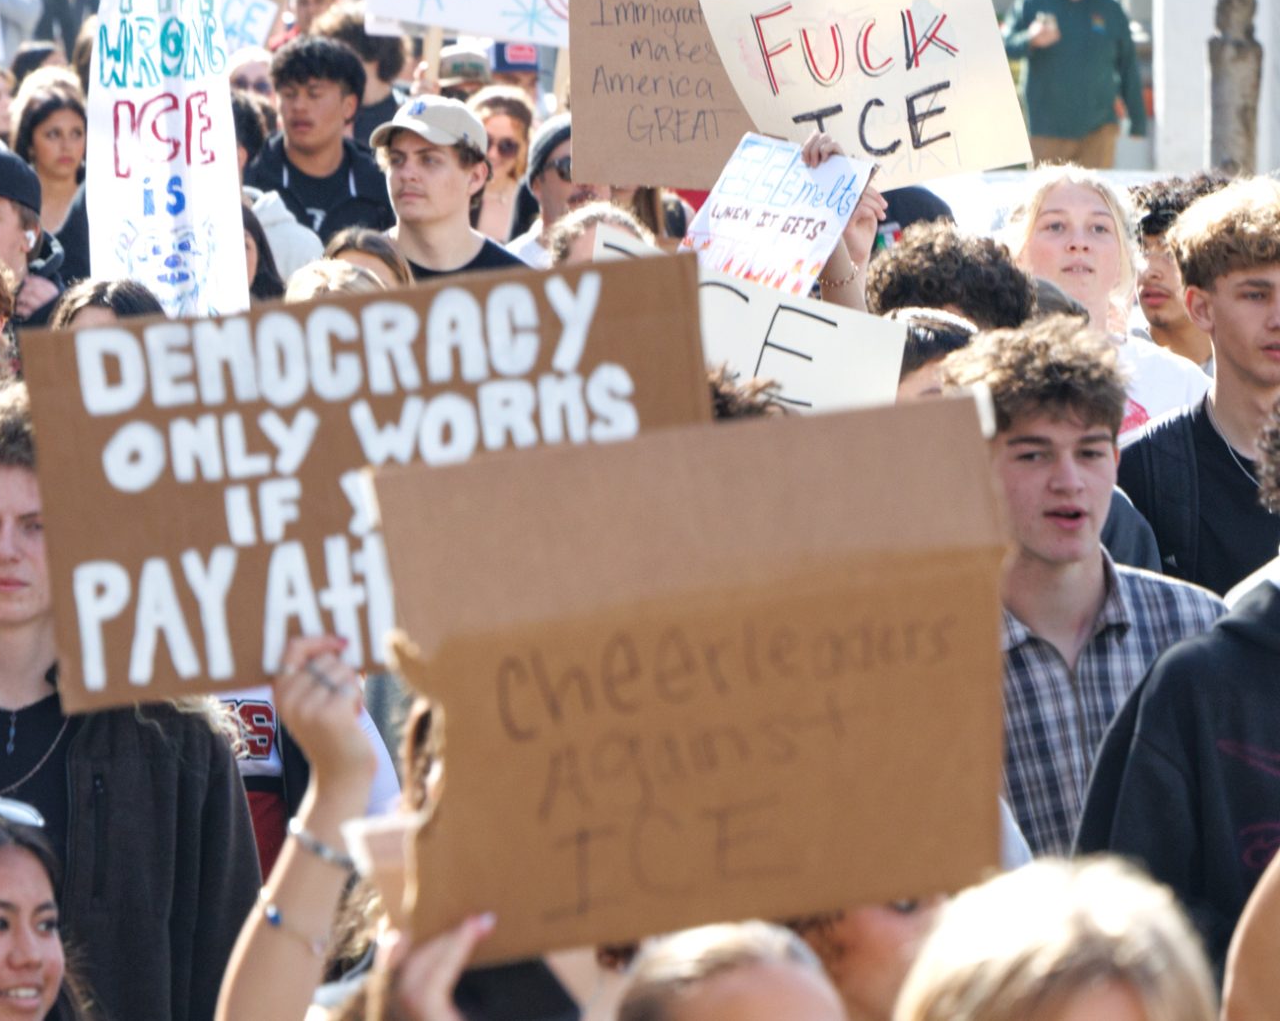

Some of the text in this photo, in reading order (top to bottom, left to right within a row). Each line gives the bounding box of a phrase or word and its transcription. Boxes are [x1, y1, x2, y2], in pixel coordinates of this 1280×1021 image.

[99, 14, 226, 89] WRONG
[592, 64, 714, 101] America
[751, 1, 959, 96] FUCK
[113, 91, 215, 179] ICE
[627, 105, 741, 147] GREAT
[792, 80, 951, 156] ICE
[142, 175, 186, 217] is
[756, 208, 780, 228] IT
[781, 215, 826, 242] GETS
[795, 173, 858, 216] melts
[75, 271, 602, 417] DEMOCRACY
[102, 406, 321, 493] ONLY
[224, 476, 303, 546] IF
[73, 544, 239, 692] PAY
[540, 791, 804, 926] ICE
